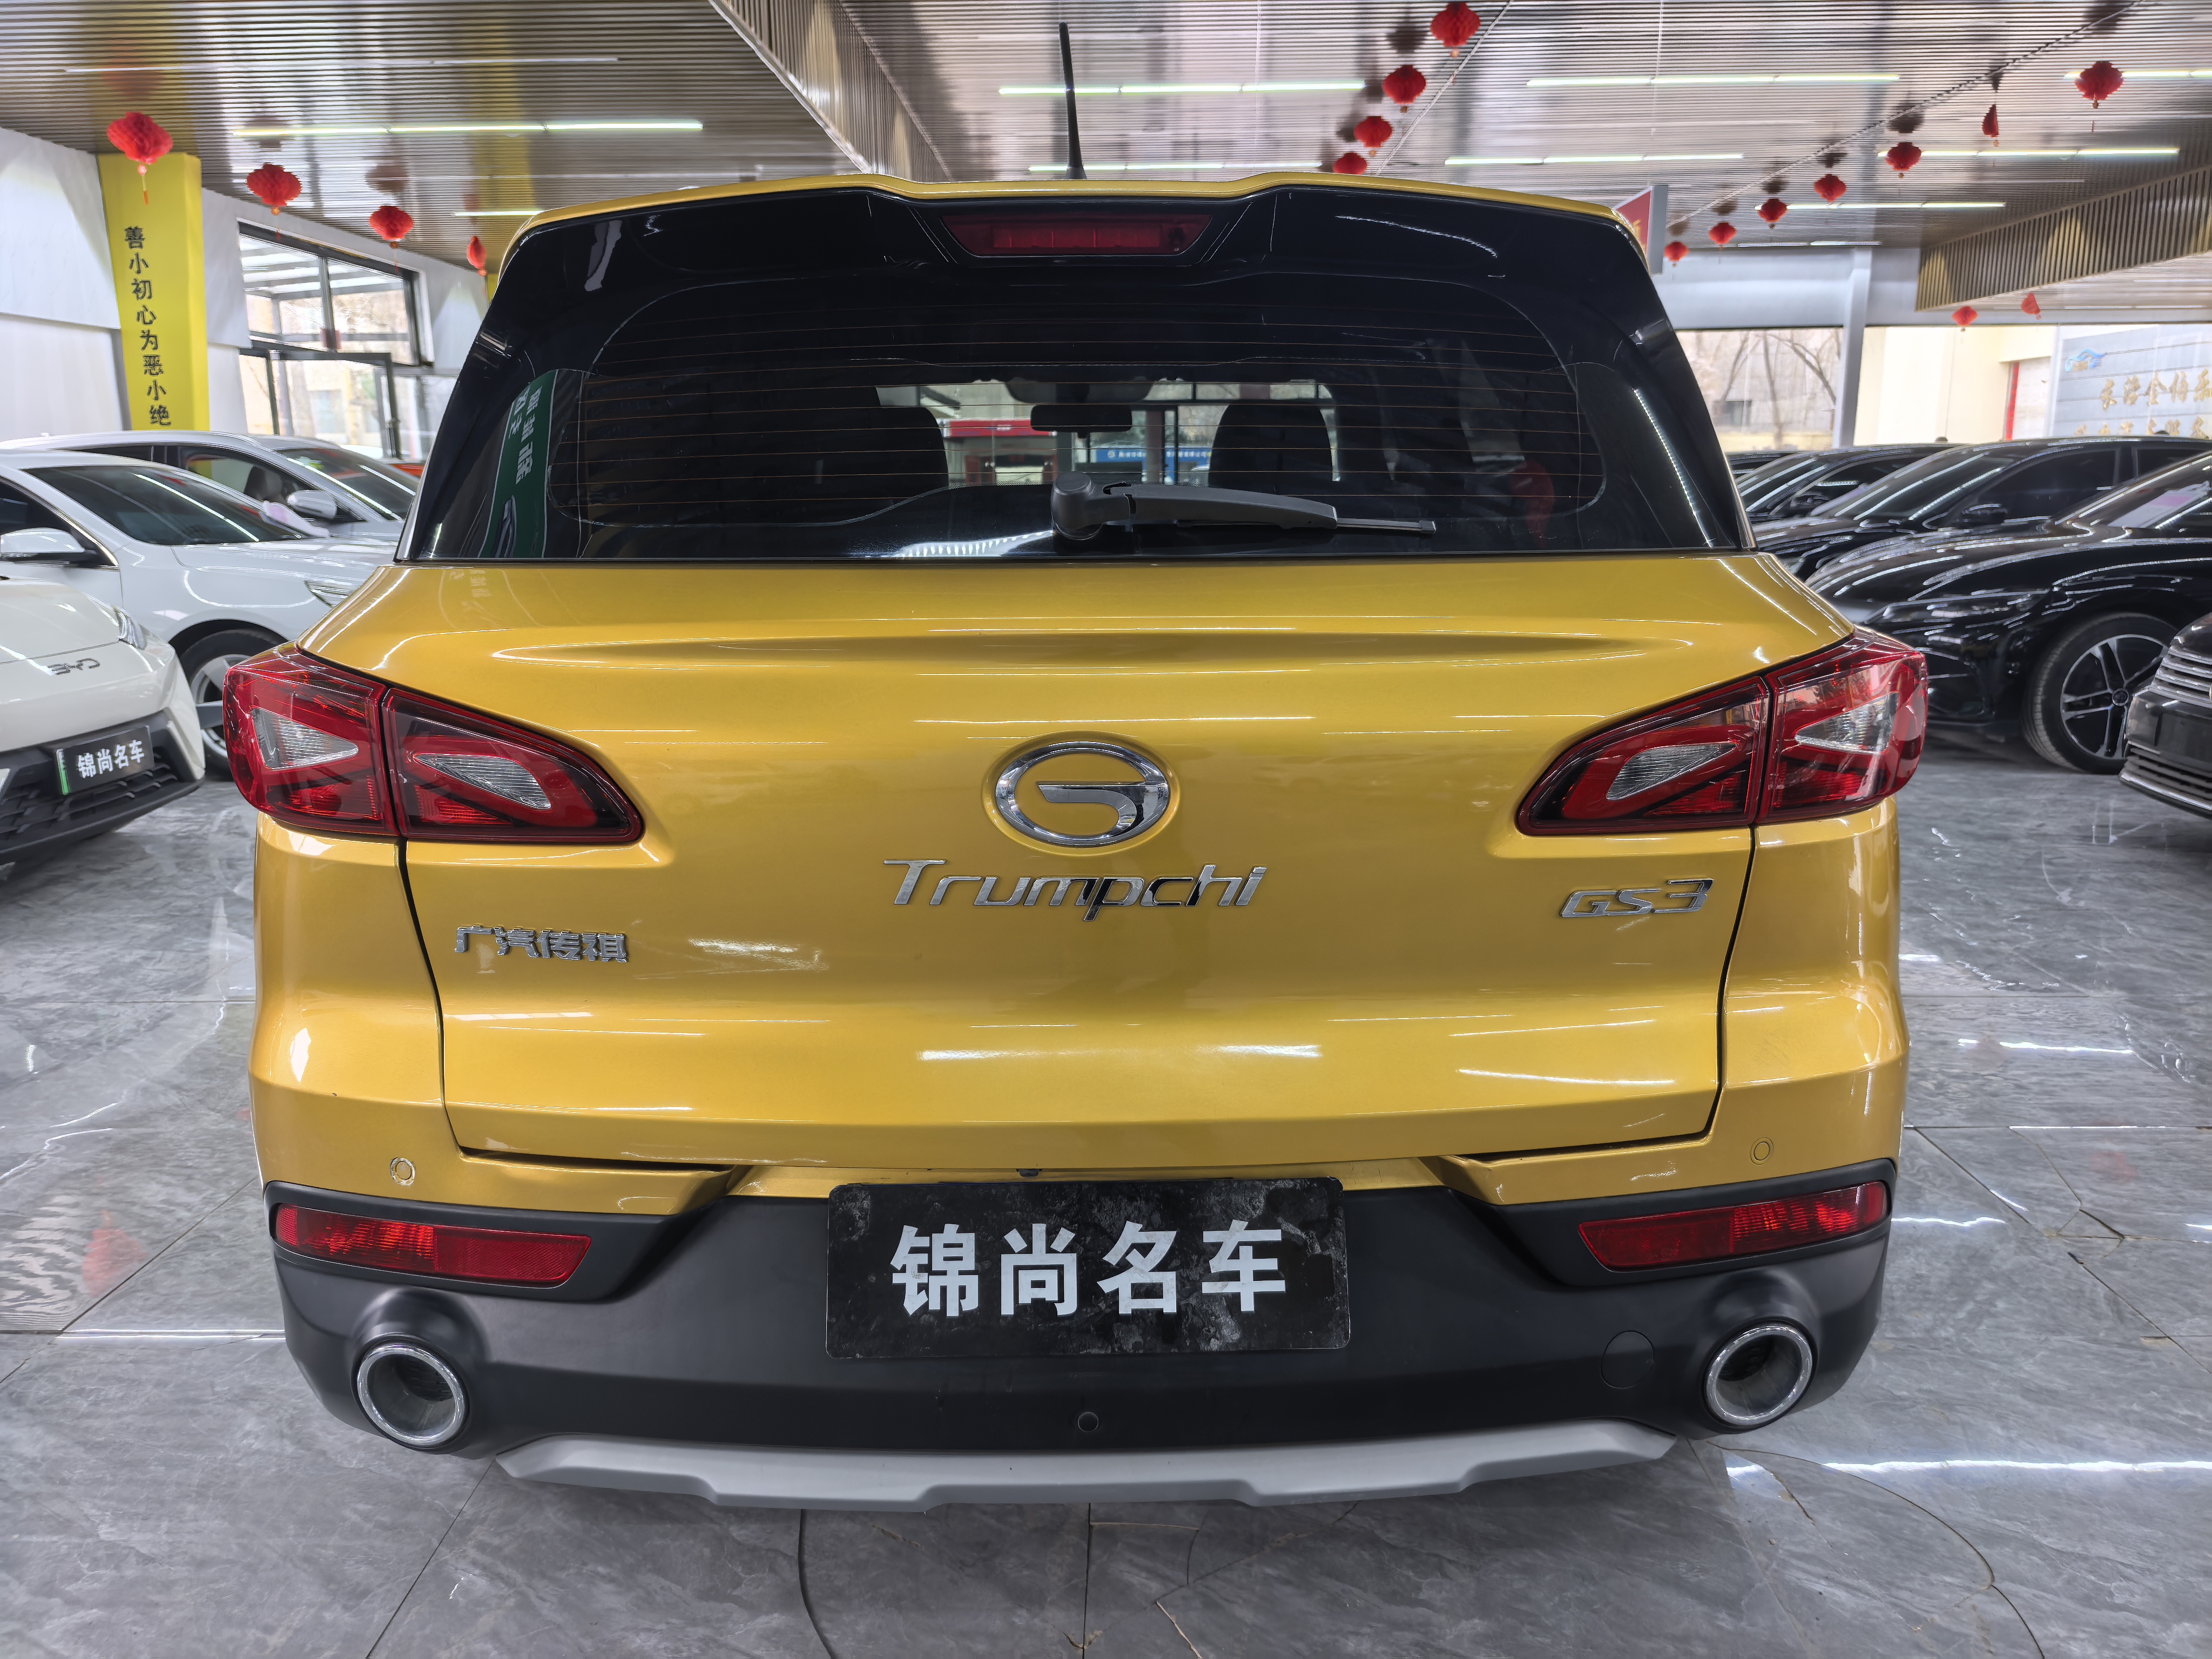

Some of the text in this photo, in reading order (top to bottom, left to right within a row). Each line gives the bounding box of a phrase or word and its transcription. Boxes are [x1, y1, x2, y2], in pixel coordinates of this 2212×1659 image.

[48, 658, 100, 675] BYD
[78, 739, 144, 778] 锦尚名车
[884, 859, 1267, 922] Trumpchi
[1560, 878, 1714, 918] GS3
[455, 925, 628, 963] 广汽传祺
[891, 1219, 1286, 1318] 锦尚名车
